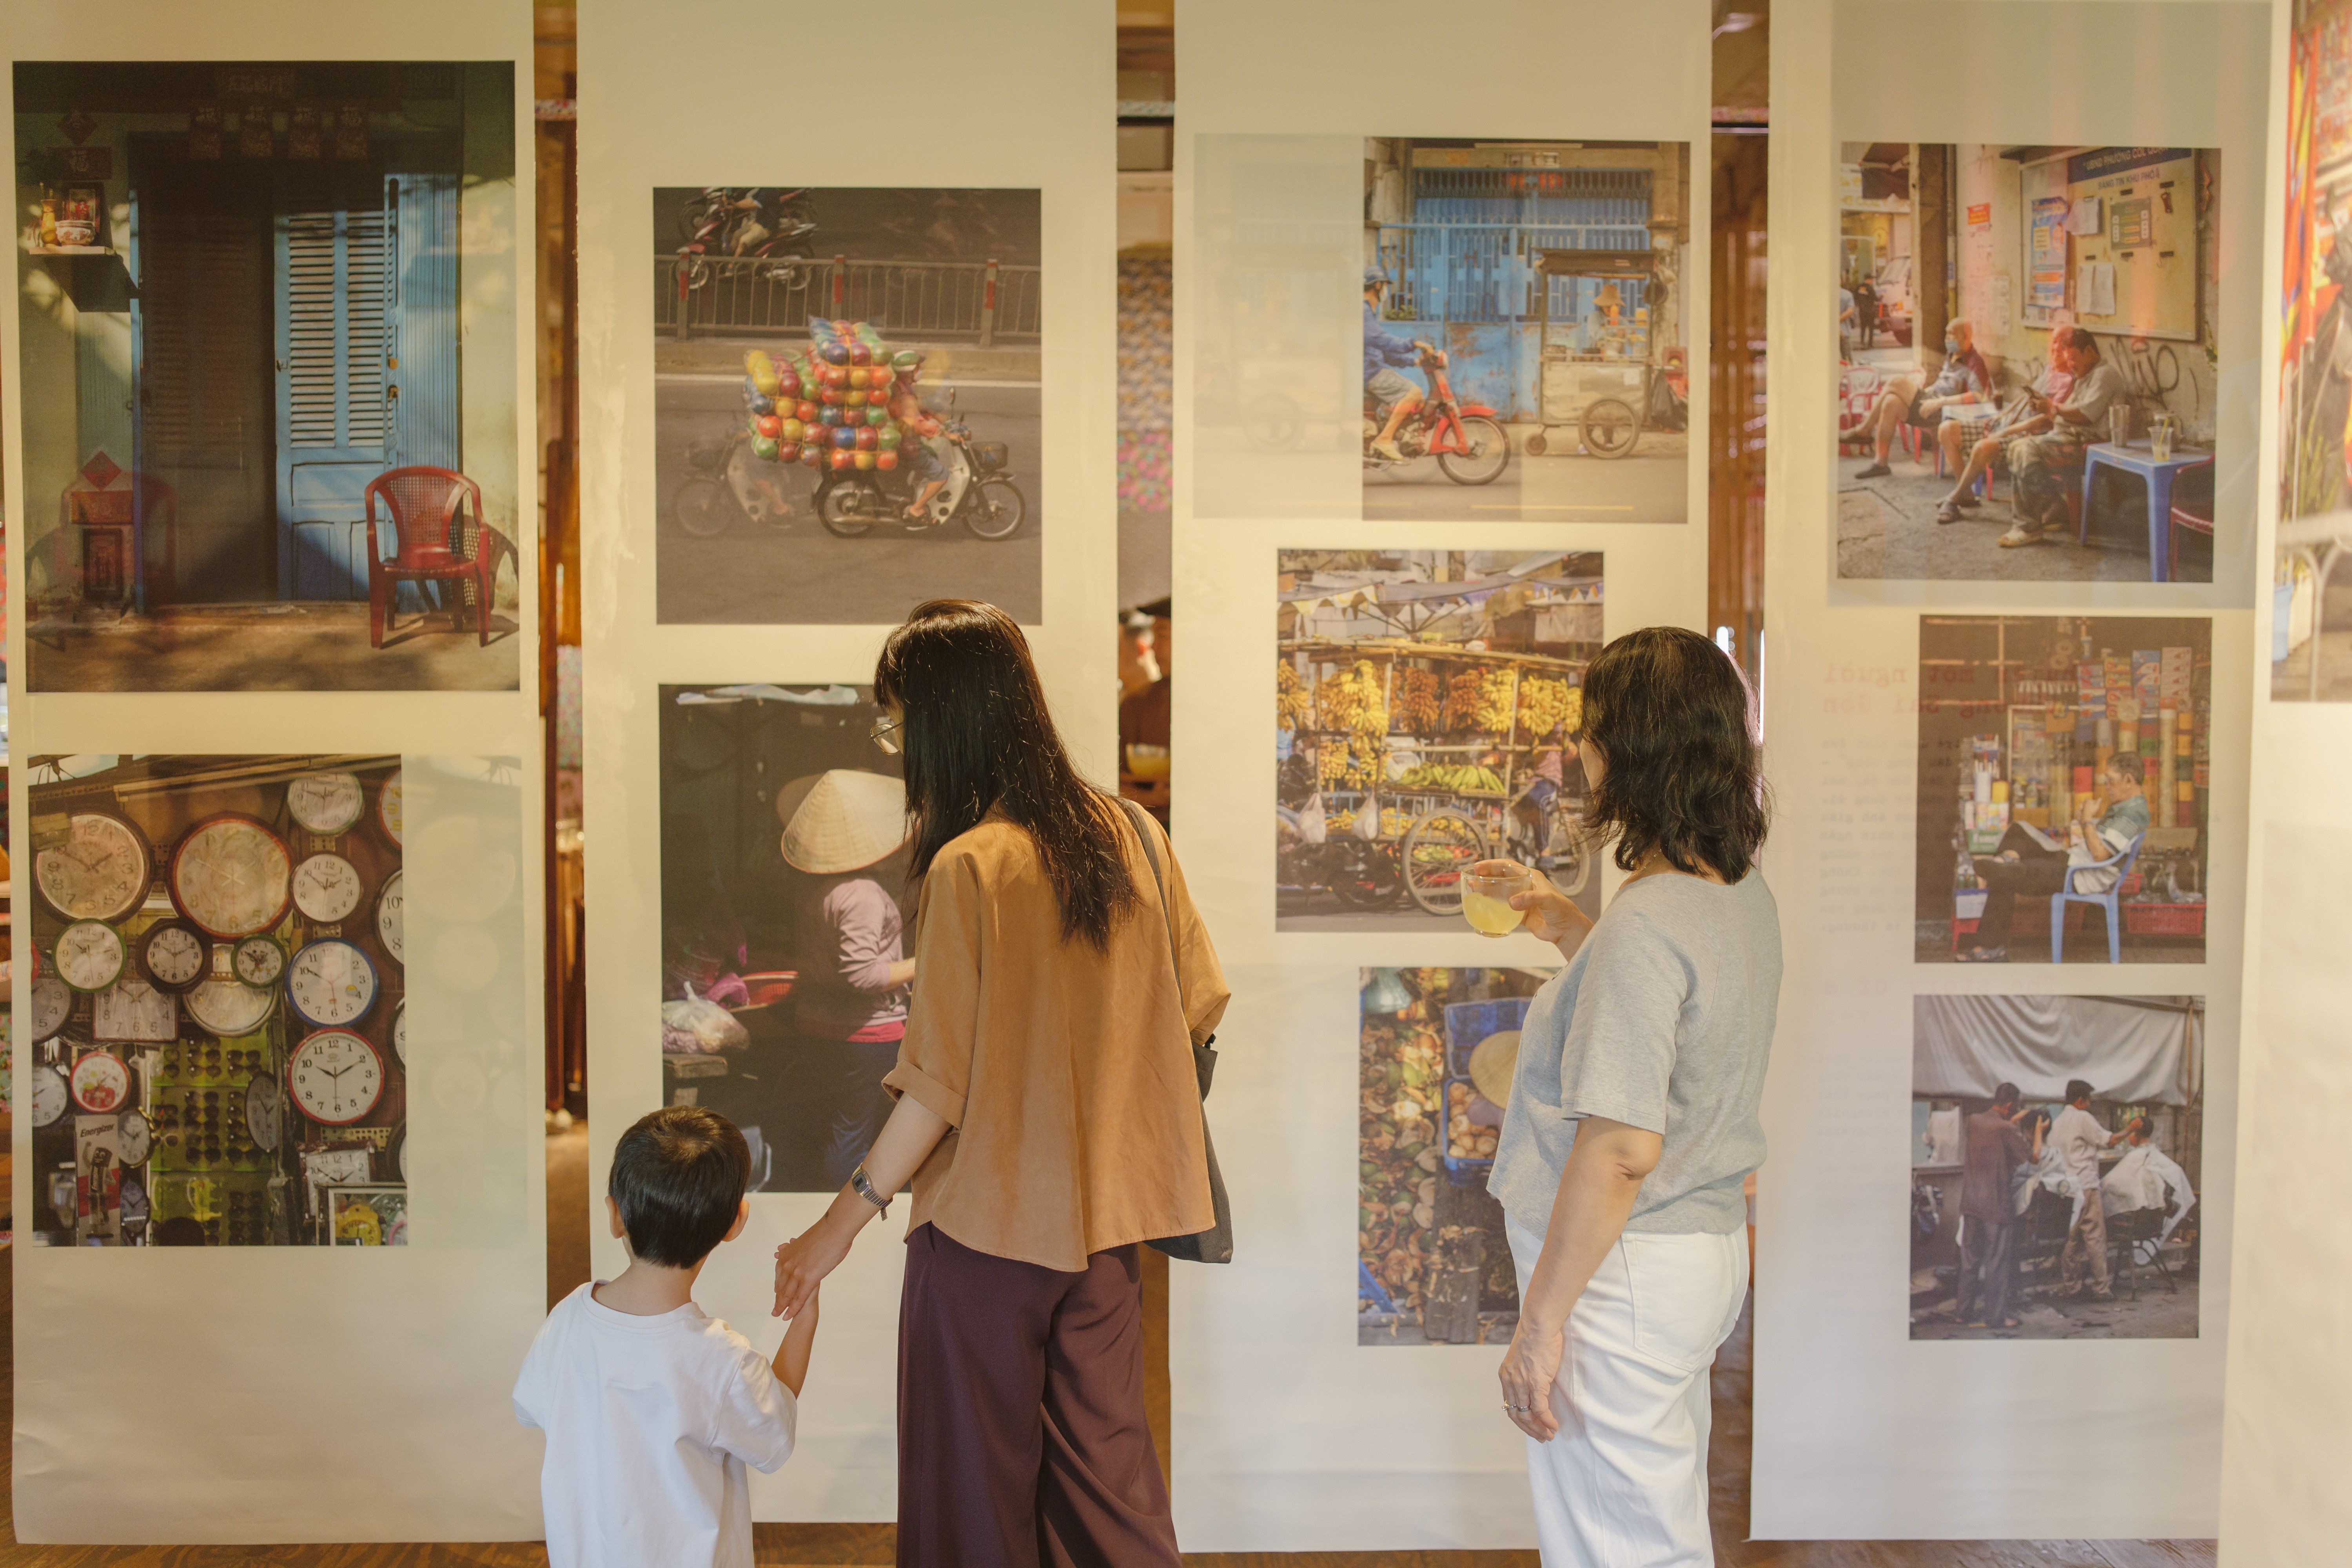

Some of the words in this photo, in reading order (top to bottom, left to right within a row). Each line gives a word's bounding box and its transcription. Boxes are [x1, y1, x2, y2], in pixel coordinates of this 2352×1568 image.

[314, 862, 321, 871] 11
[325, 861, 335, 870] 12
[339, 866, 343, 875] 1
[118, 880, 128, 891] 4
[66, 893, 76, 904] 7
[386, 895, 400, 910] 10
[383, 916, 392, 931] 9
[184, 933, 188, 942] 1
[392, 937, 402, 951] 8
[62, 949, 69, 958] 9
[309, 953, 317, 962] 11
[64, 961, 71, 970] 8
[352, 960, 360, 970] 2
[299, 966, 310, 975] 10
[359, 975, 366, 984] 3
[296, 980, 303, 991] 9
[53, 991, 63, 1000] 3
[303, 996, 310, 1005] 8
[49, 1006, 58, 1015] 4
[315, 1005, 321, 1015] 7
[330, 1007, 338, 1018] 6
[346, 1003, 353, 1013] 5
[103, 1009, 111, 1020] 8
[162, 1010, 169, 1021] 4
[38, 1018, 48, 1028] 5
[116, 1022, 123, 1033] 7
[133, 1021, 140, 1033] 6
[150, 1021, 157, 1033] 5
[328, 1039, 339, 1049] 12
[347, 1043, 352, 1053] 1
[314, 1045, 323, 1055] 11
[301, 1058, 313, 1069] 10
[359, 1054, 366, 1064] 2
[298, 1074, 306, 1084] 9
[365, 1069, 372, 1079] 3
[305, 1090, 313, 1100] 8
[361, 1085, 368, 1095] 4
[317, 1101, 324, 1111] 7
[334, 1103, 341, 1113] 6
[350, 1098, 357, 1108] 5
[80, 1123, 114, 1138] Energizer
[333, 1153, 342, 1164] 12
[348, 1153, 352, 1163] 1
[358, 1162, 364, 1172] 2
